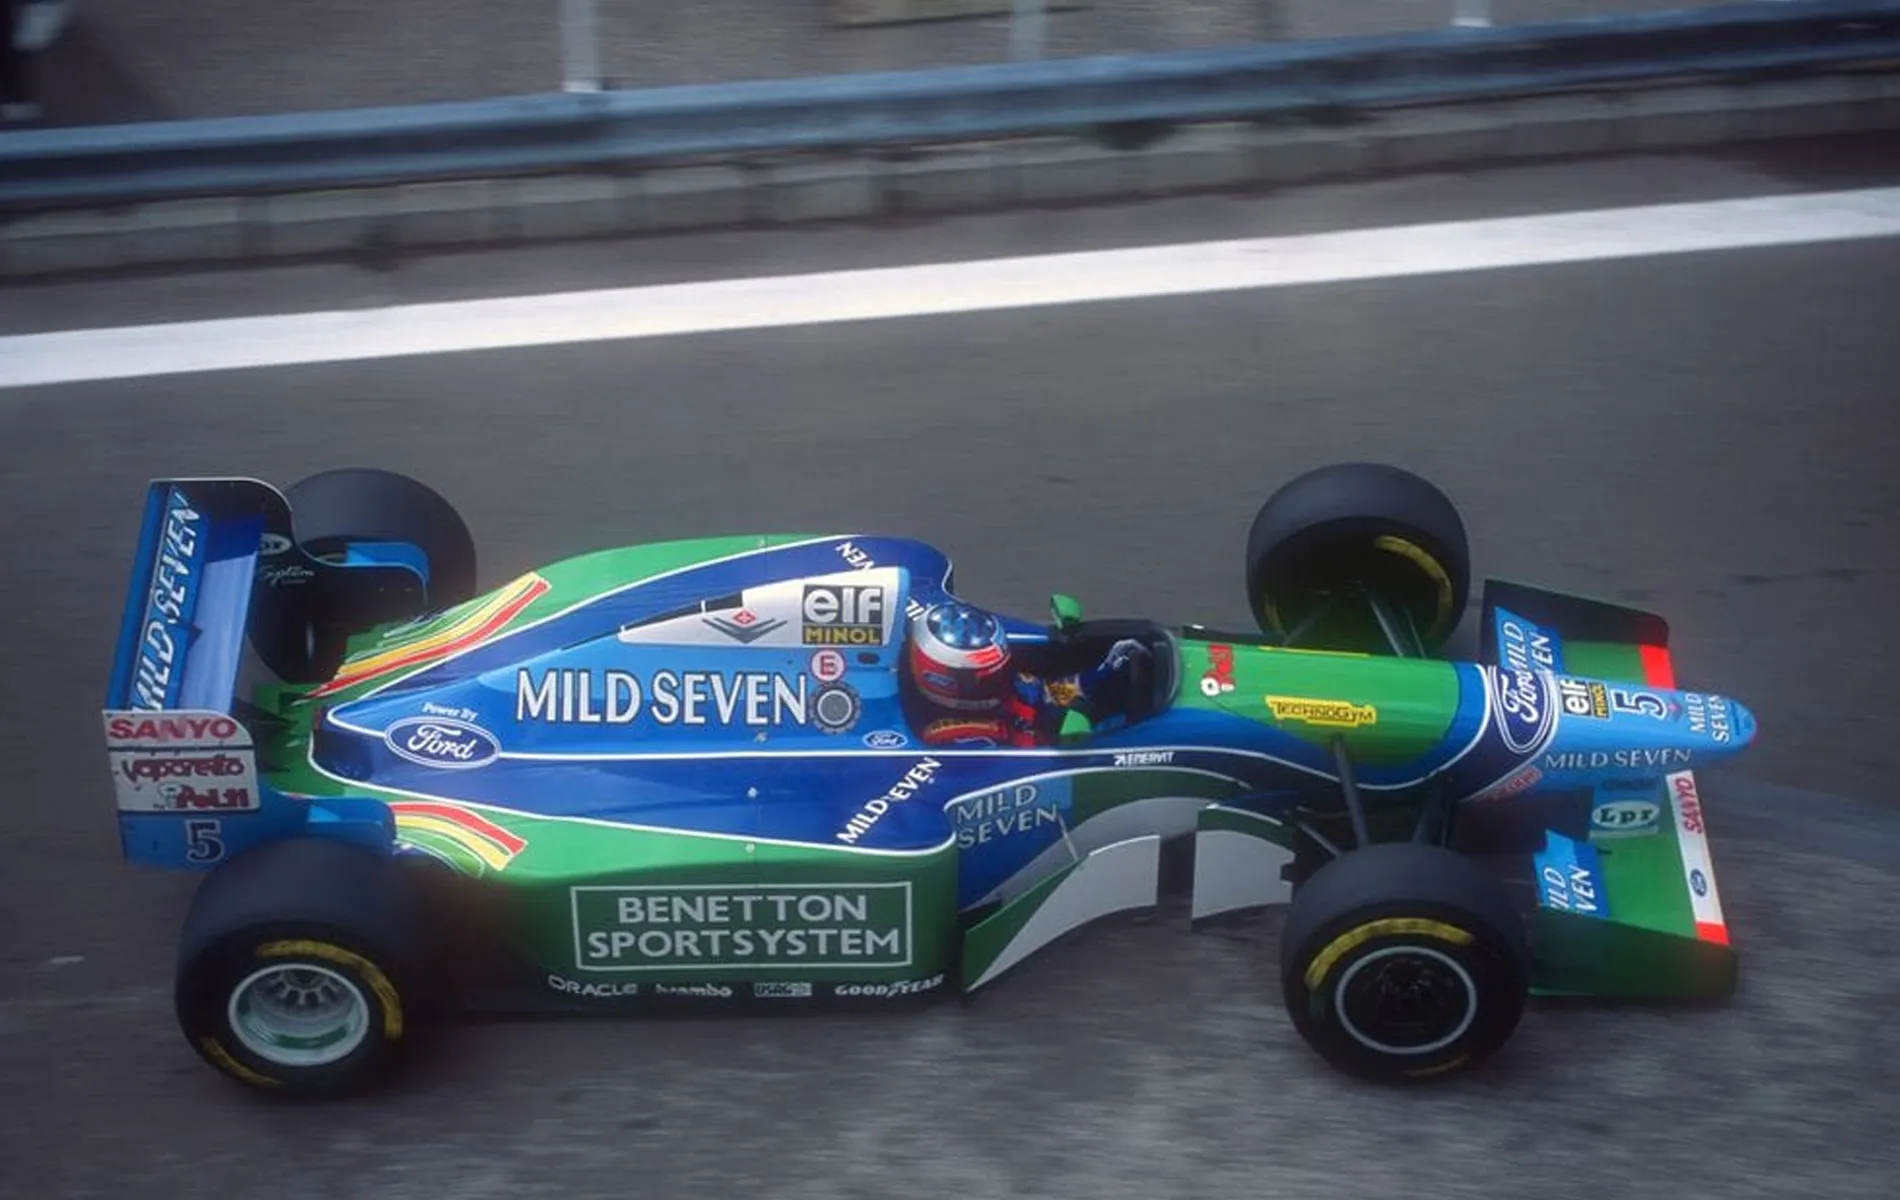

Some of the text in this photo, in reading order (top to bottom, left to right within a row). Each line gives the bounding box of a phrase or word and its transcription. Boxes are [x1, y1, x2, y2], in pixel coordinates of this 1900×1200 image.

[153, 491, 201, 624] SEVEN
[804, 588, 881, 623] elf
[805, 627, 880, 644] MINOL
[819, 654, 836, 676] E
[515, 670, 808, 725] MILD SEVEN
[1271, 701, 1374, 723] TECHNOGYM
[1560, 679, 1590, 714] elf
[1610, 688, 1667, 720] 5
[1685, 692, 1706, 733] MILD
[109, 718, 238, 739] SANYO
[407, 724, 477, 759] Ford
[1545, 748, 1692, 769] MILD SEVEN
[836, 756, 943, 844] MILD EVEN
[956, 784, 1037, 825] MILD
[185, 818, 224, 862] 5
[956, 803, 1059, 850] SEVEN
[1544, 867, 1570, 909] ILD
[617, 894, 867, 924] BENETTON
[587, 928, 900, 959] SPORTSYSTEM
[547, 974, 640, 998] ORACLE
[834, 973, 945, 998] GOODYEAR
